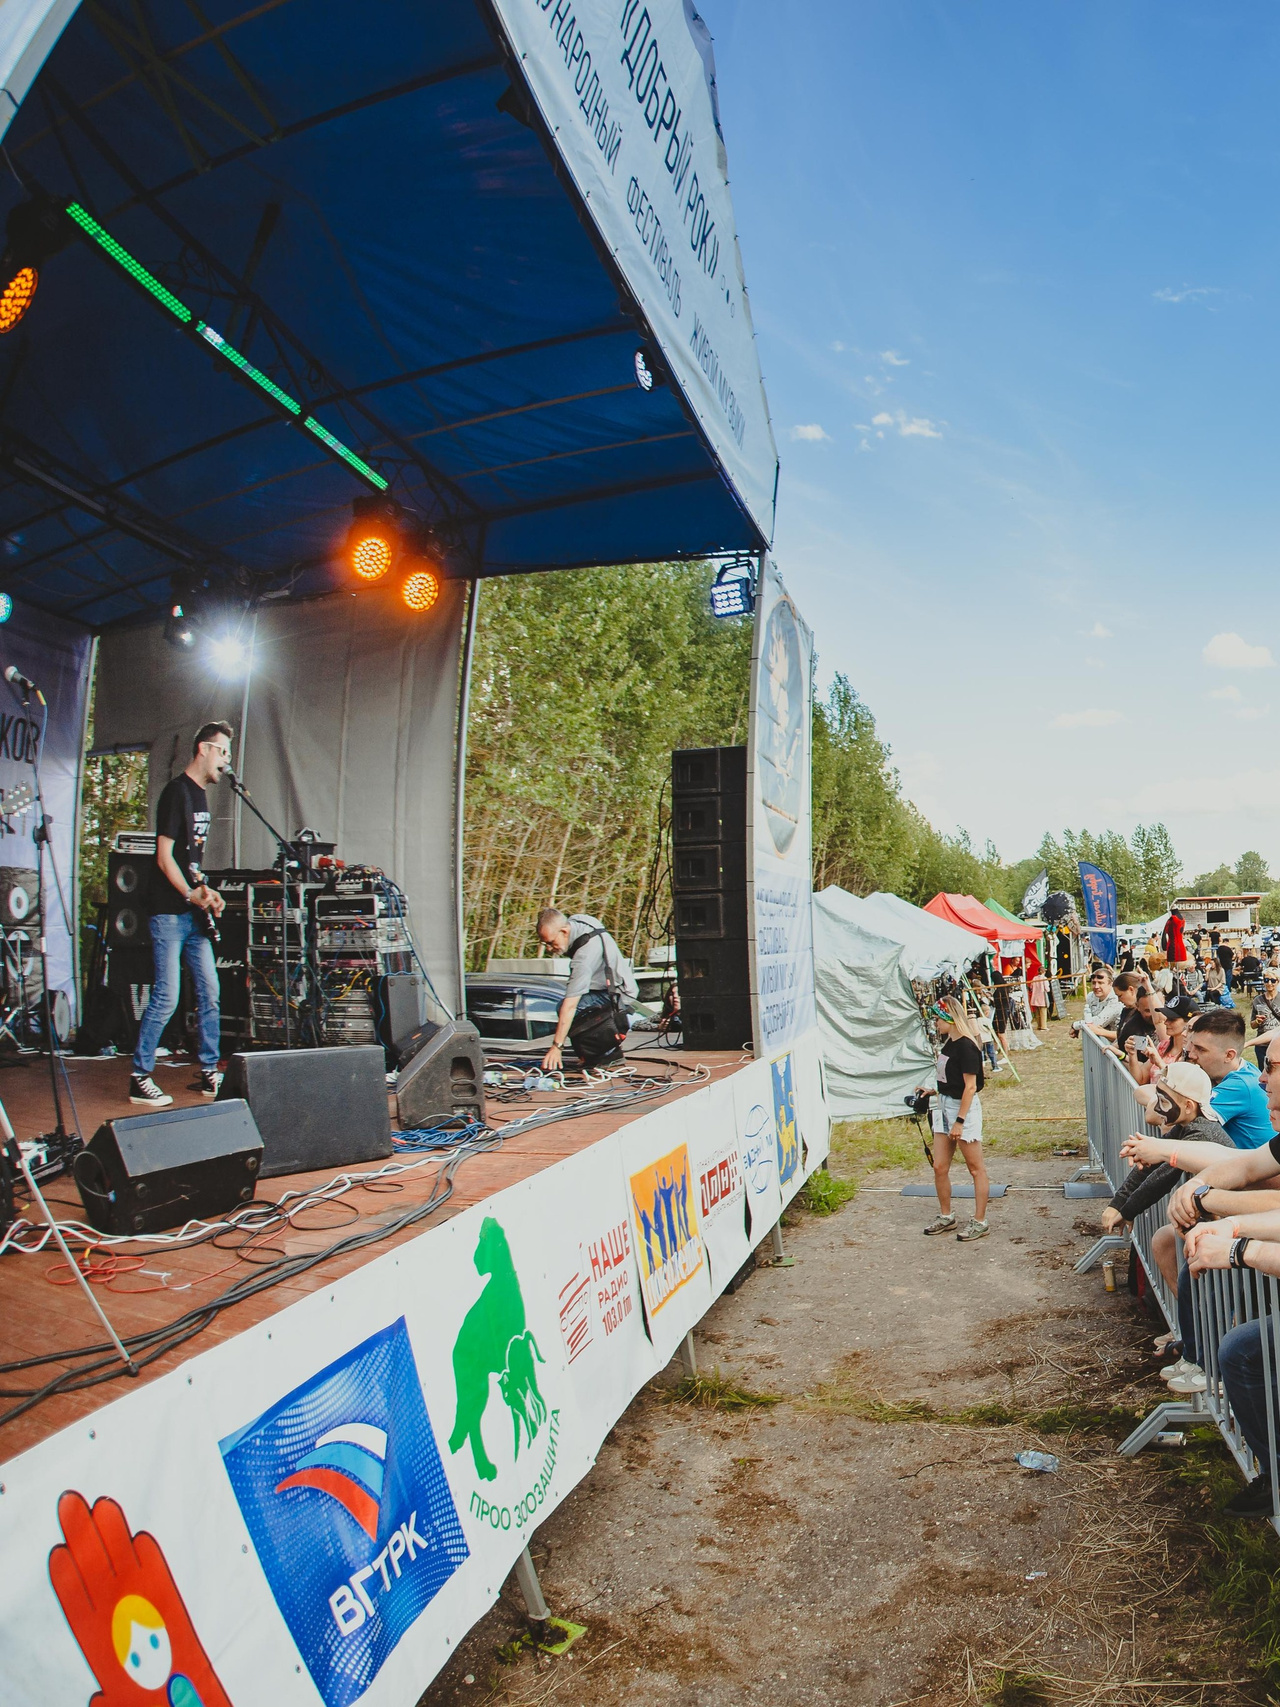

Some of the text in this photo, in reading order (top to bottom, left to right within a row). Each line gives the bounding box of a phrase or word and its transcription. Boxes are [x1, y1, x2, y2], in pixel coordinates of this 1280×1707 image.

[627, 176, 681, 318] ФЕСТИВАЛЬ
[689, 312, 719, 395] ЖИВОЙ
[588, 1220, 631, 1283] НАШЕ
[598, 1269, 629, 1308] РАДИО
[469, 1408, 560, 1531] ПРОО ЗООЗАЩИТА
[329, 1510, 429, 1637] ВГТРК
